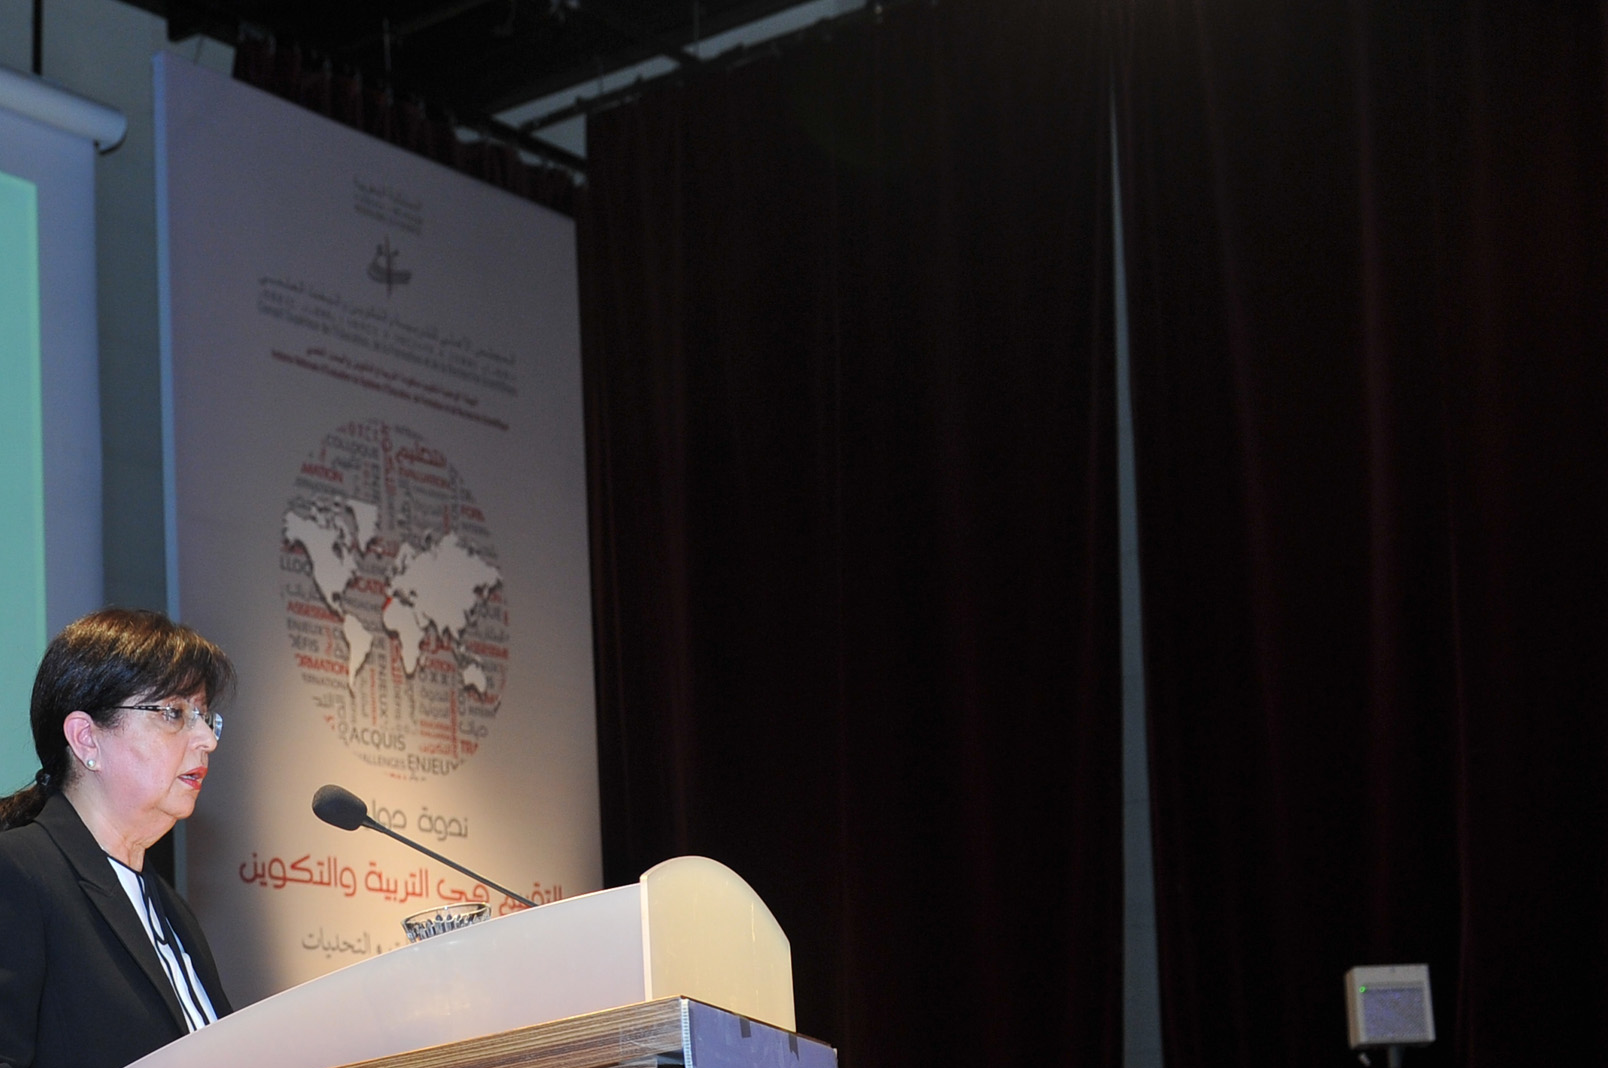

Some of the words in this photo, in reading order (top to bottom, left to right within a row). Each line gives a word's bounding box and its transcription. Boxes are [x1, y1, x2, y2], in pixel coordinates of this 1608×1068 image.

[349, 726, 407, 752] ACQUIS
[417, 805, 468, 841] ندوة
[238, 853, 358, 897] والتكوين
[364, 861, 430, 904] التربية
